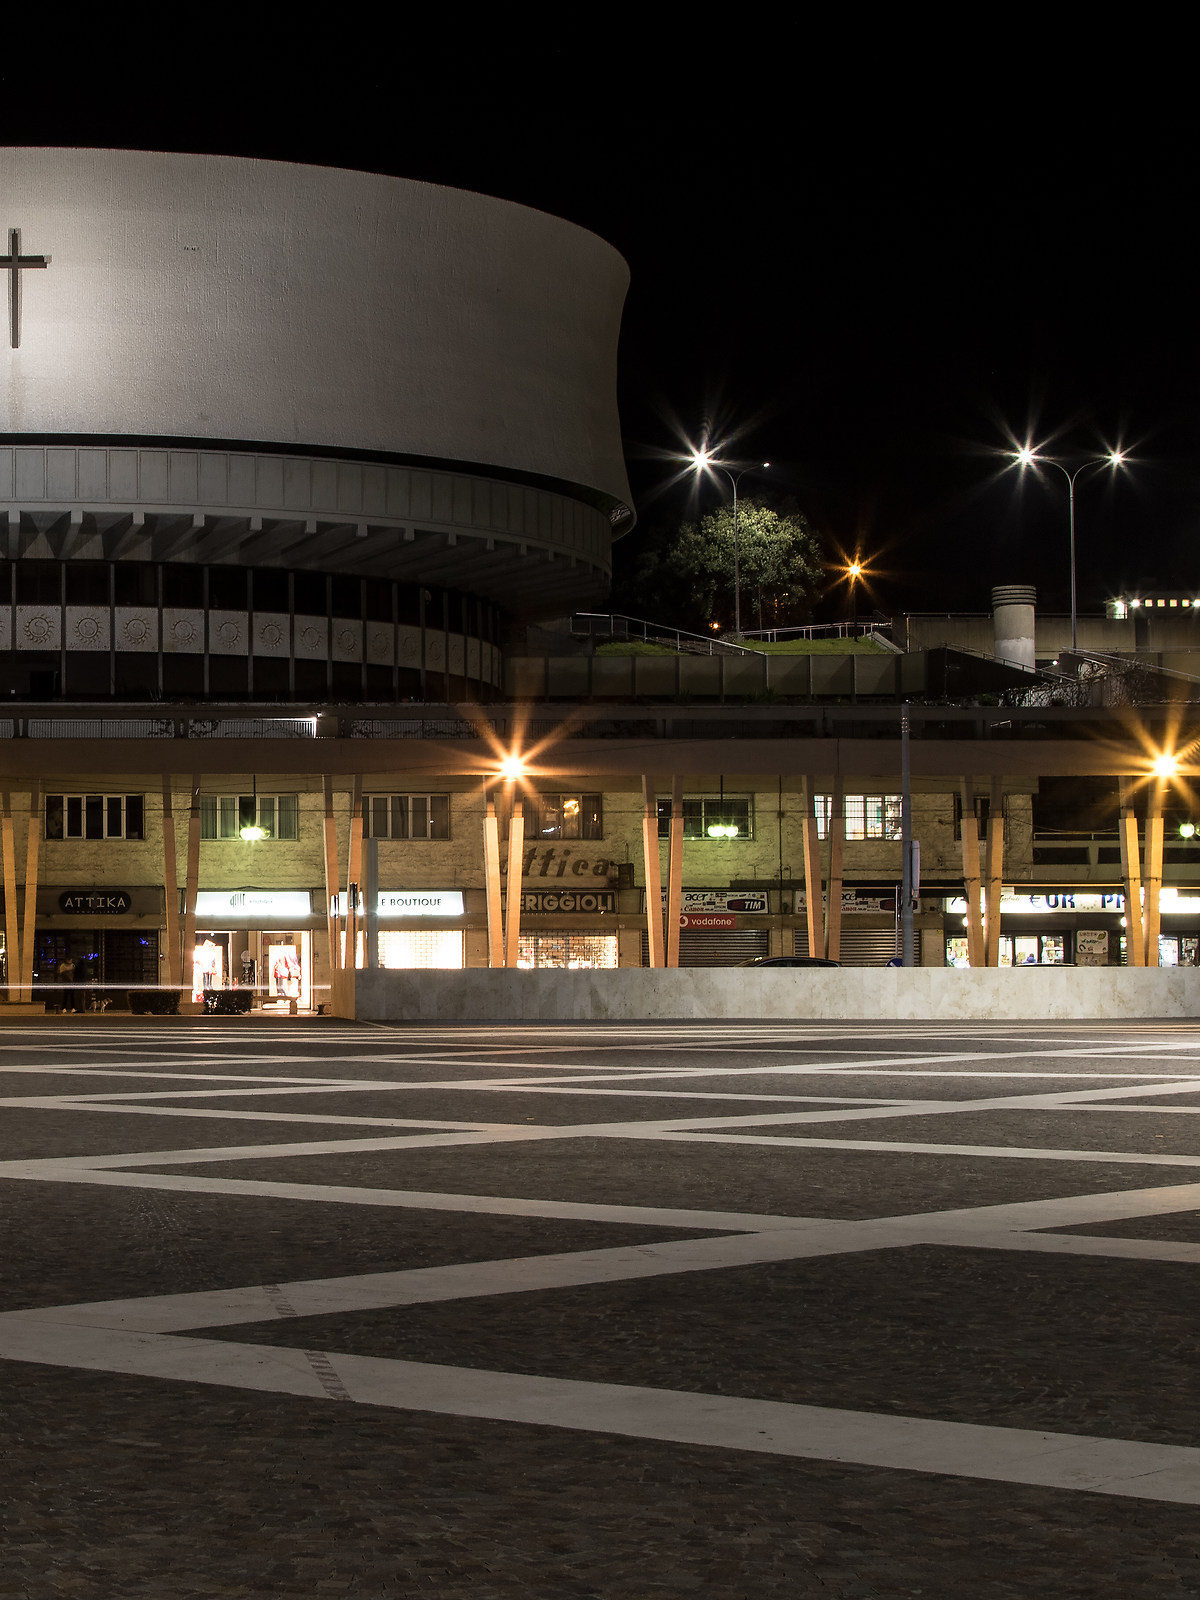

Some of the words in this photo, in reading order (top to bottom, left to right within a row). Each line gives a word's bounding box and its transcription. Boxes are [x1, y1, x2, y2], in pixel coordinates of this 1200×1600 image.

[685, 893, 708, 901] acer
[65, 897, 126, 908] ATTIKA
[390, 898, 442, 907] BOUTIQUE
[744, 900, 761, 910] TIM
[684, 904, 705, 912] Canon
[691, 917, 732, 926] vodafone
